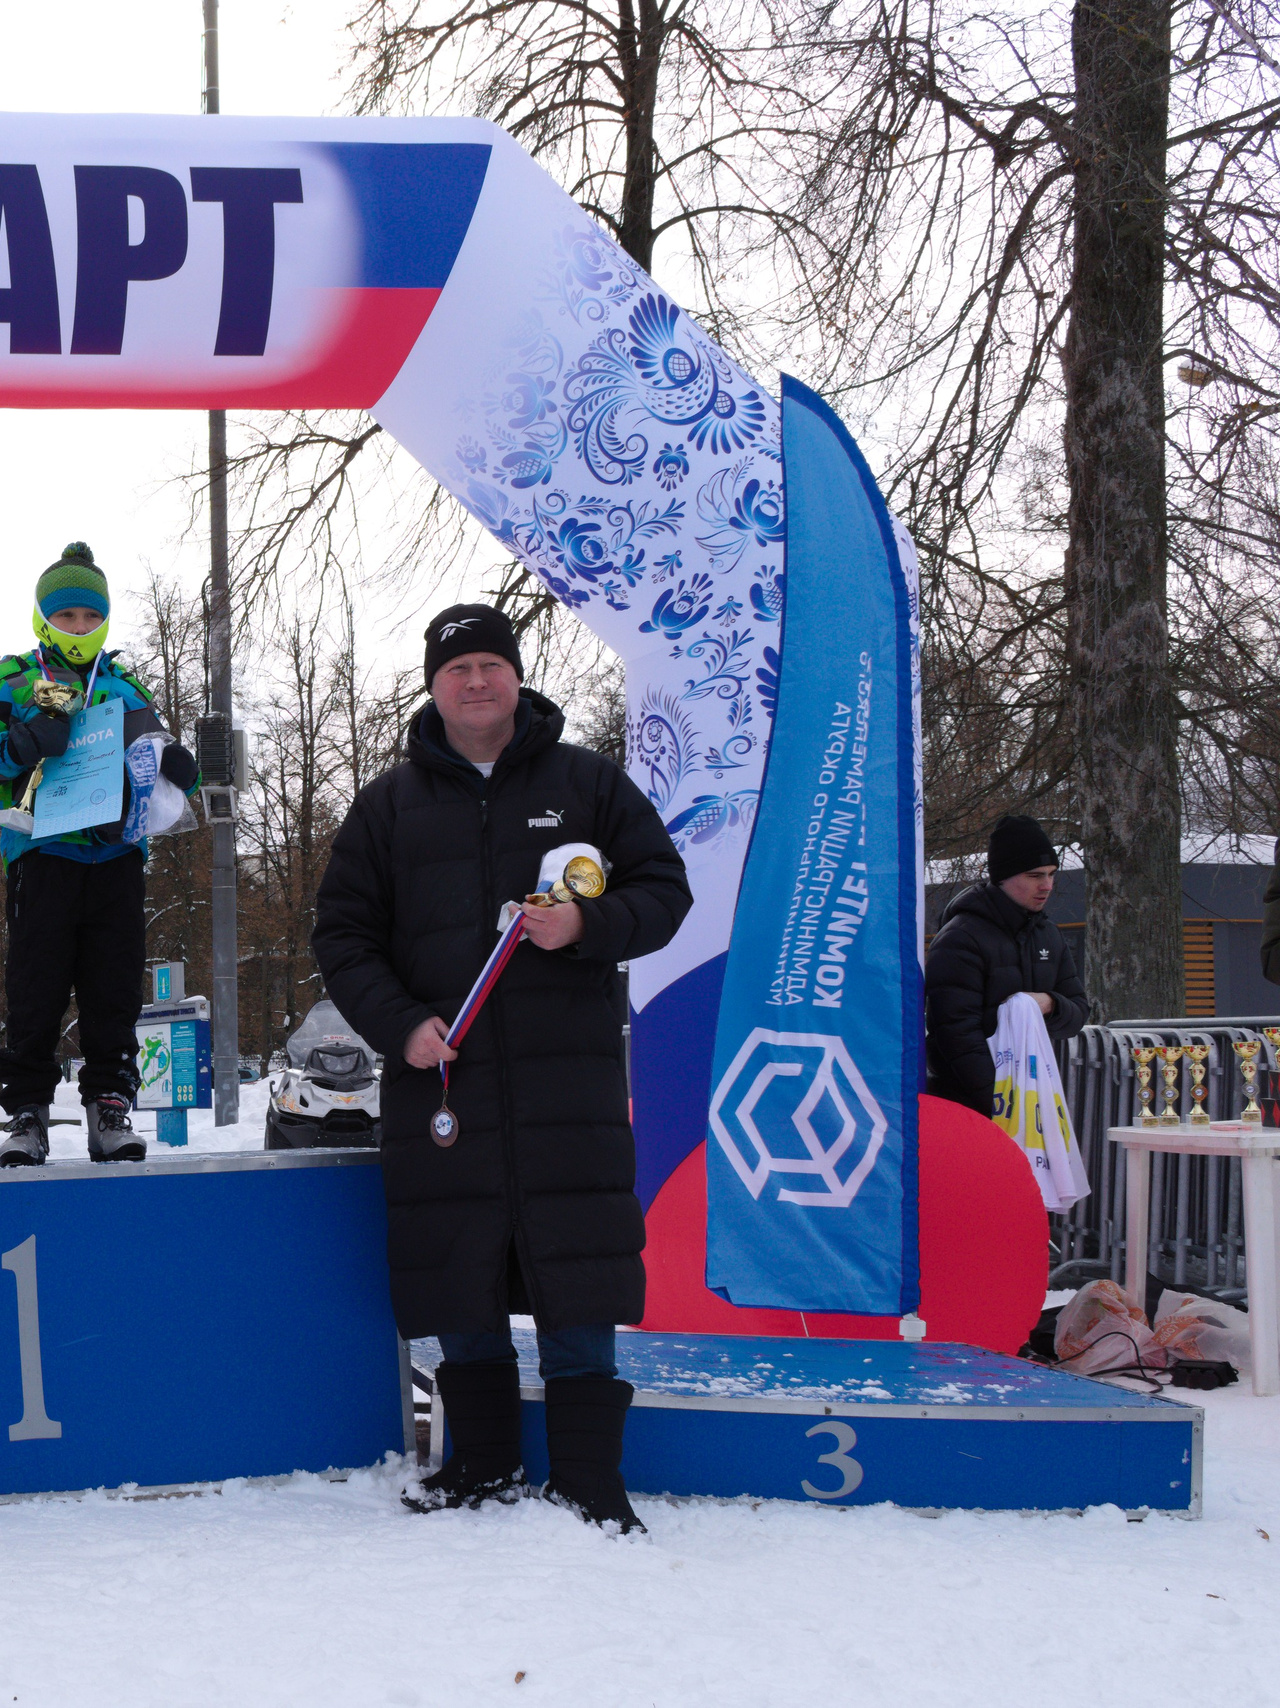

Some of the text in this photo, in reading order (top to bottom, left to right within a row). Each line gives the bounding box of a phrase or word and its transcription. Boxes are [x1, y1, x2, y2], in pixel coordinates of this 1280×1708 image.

[66, 728, 114, 750] АМОТА
[528, 817, 558, 828] PUMA
[1, 1233, 62, 1442] 1
[800, 1420, 864, 1499] 3
